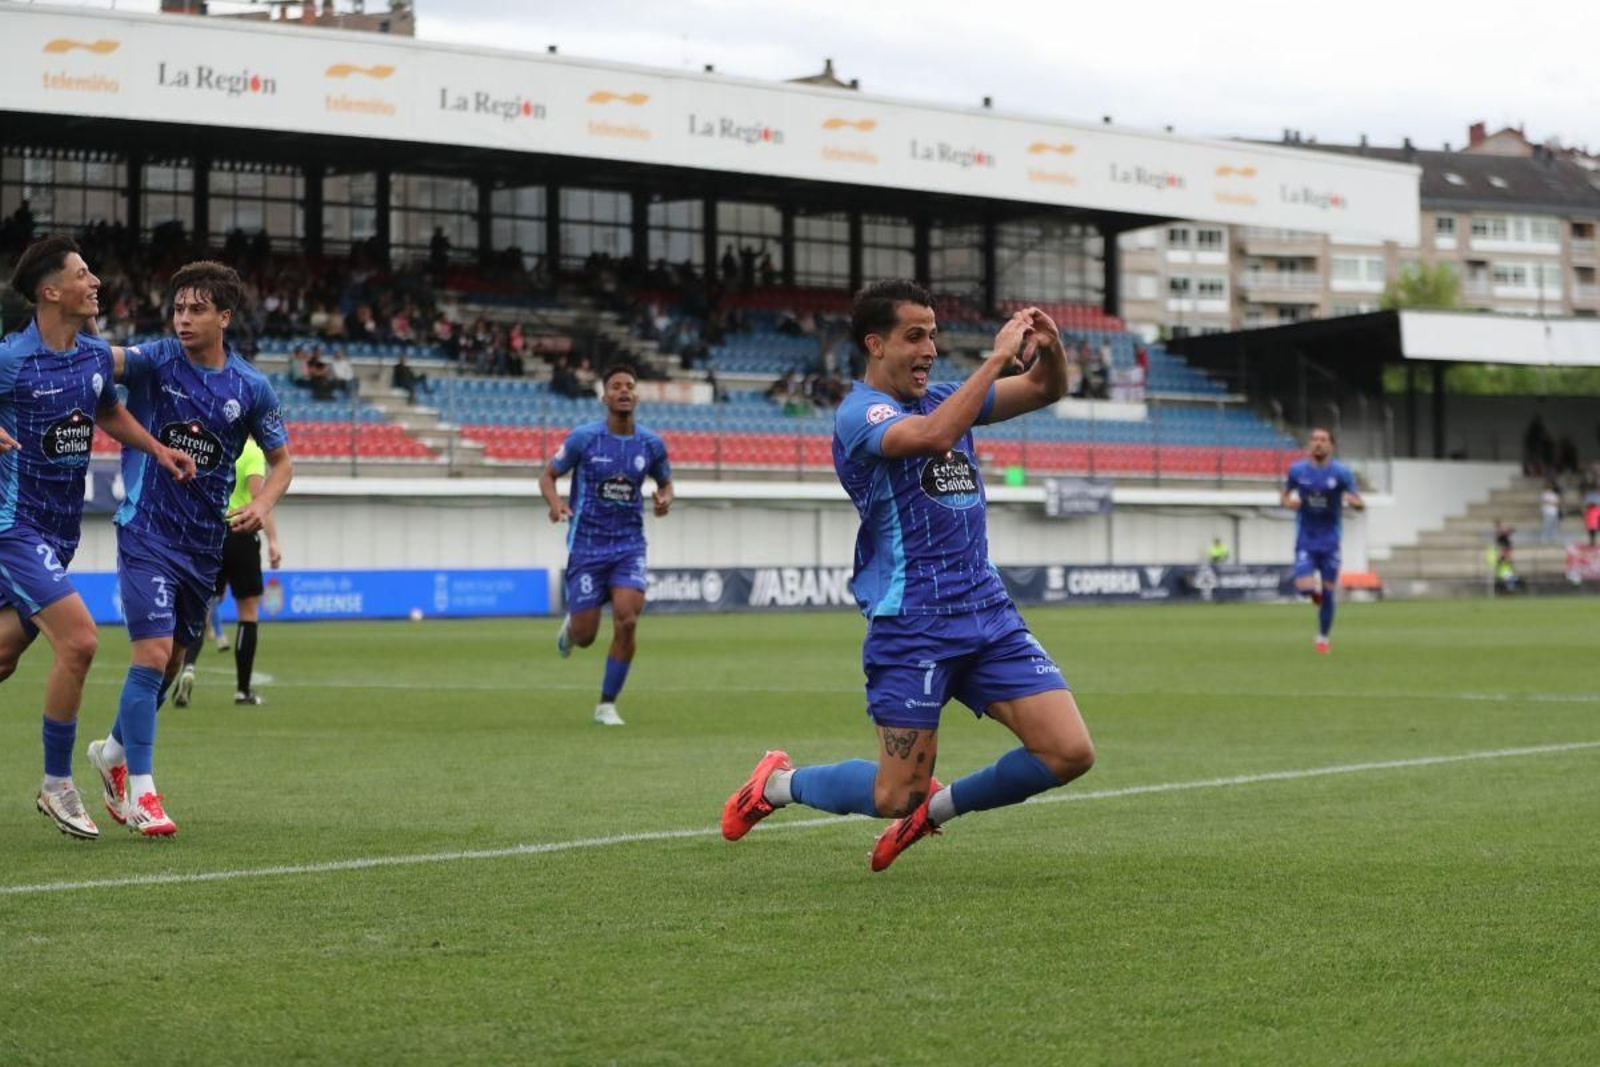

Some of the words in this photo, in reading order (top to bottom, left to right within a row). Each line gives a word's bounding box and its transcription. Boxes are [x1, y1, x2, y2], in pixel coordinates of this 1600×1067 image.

[158, 62, 189, 87] La
[440, 88, 468, 111] La
[688, 114, 714, 136] La
[910, 140, 934, 160] La
[56, 425, 90, 440] Estrella
[169, 428, 214, 453] Estrella
[55, 439, 88, 454] Galicia
[933, 463, 970, 477] Estrella
[935, 477, 976, 492] Galicia
[36, 544, 64, 570] 2
[152, 576, 169, 608] 3
[580, 573, 594, 594] 8
[750, 569, 857, 606] ABANC
[291, 594, 363, 613] OURENSE
[917, 660, 937, 695] 7
